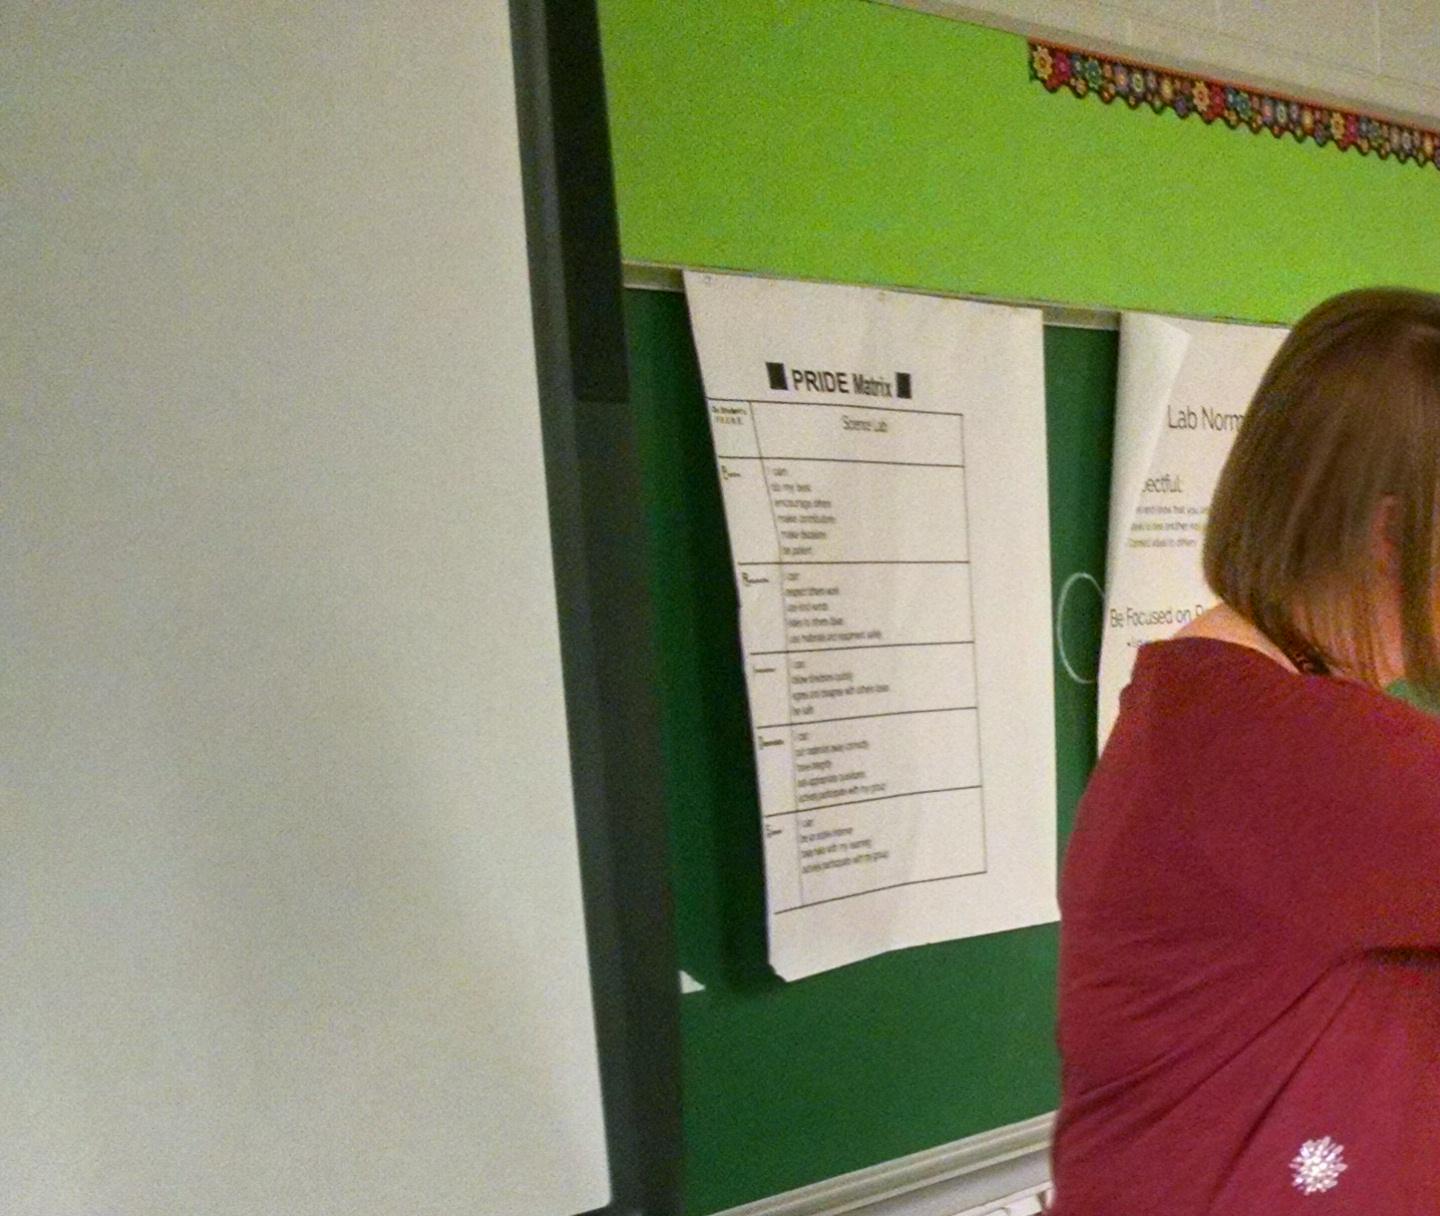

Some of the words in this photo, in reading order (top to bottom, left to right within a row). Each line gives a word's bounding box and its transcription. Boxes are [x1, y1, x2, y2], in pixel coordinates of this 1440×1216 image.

[791, 368, 850, 394] PRIDE
[852, 373, 894, 398] Matrix
[1167, 405, 1198, 430] Lab
[1110, 607, 1125, 629] Be
[1126, 605, 1174, 627] Focused
